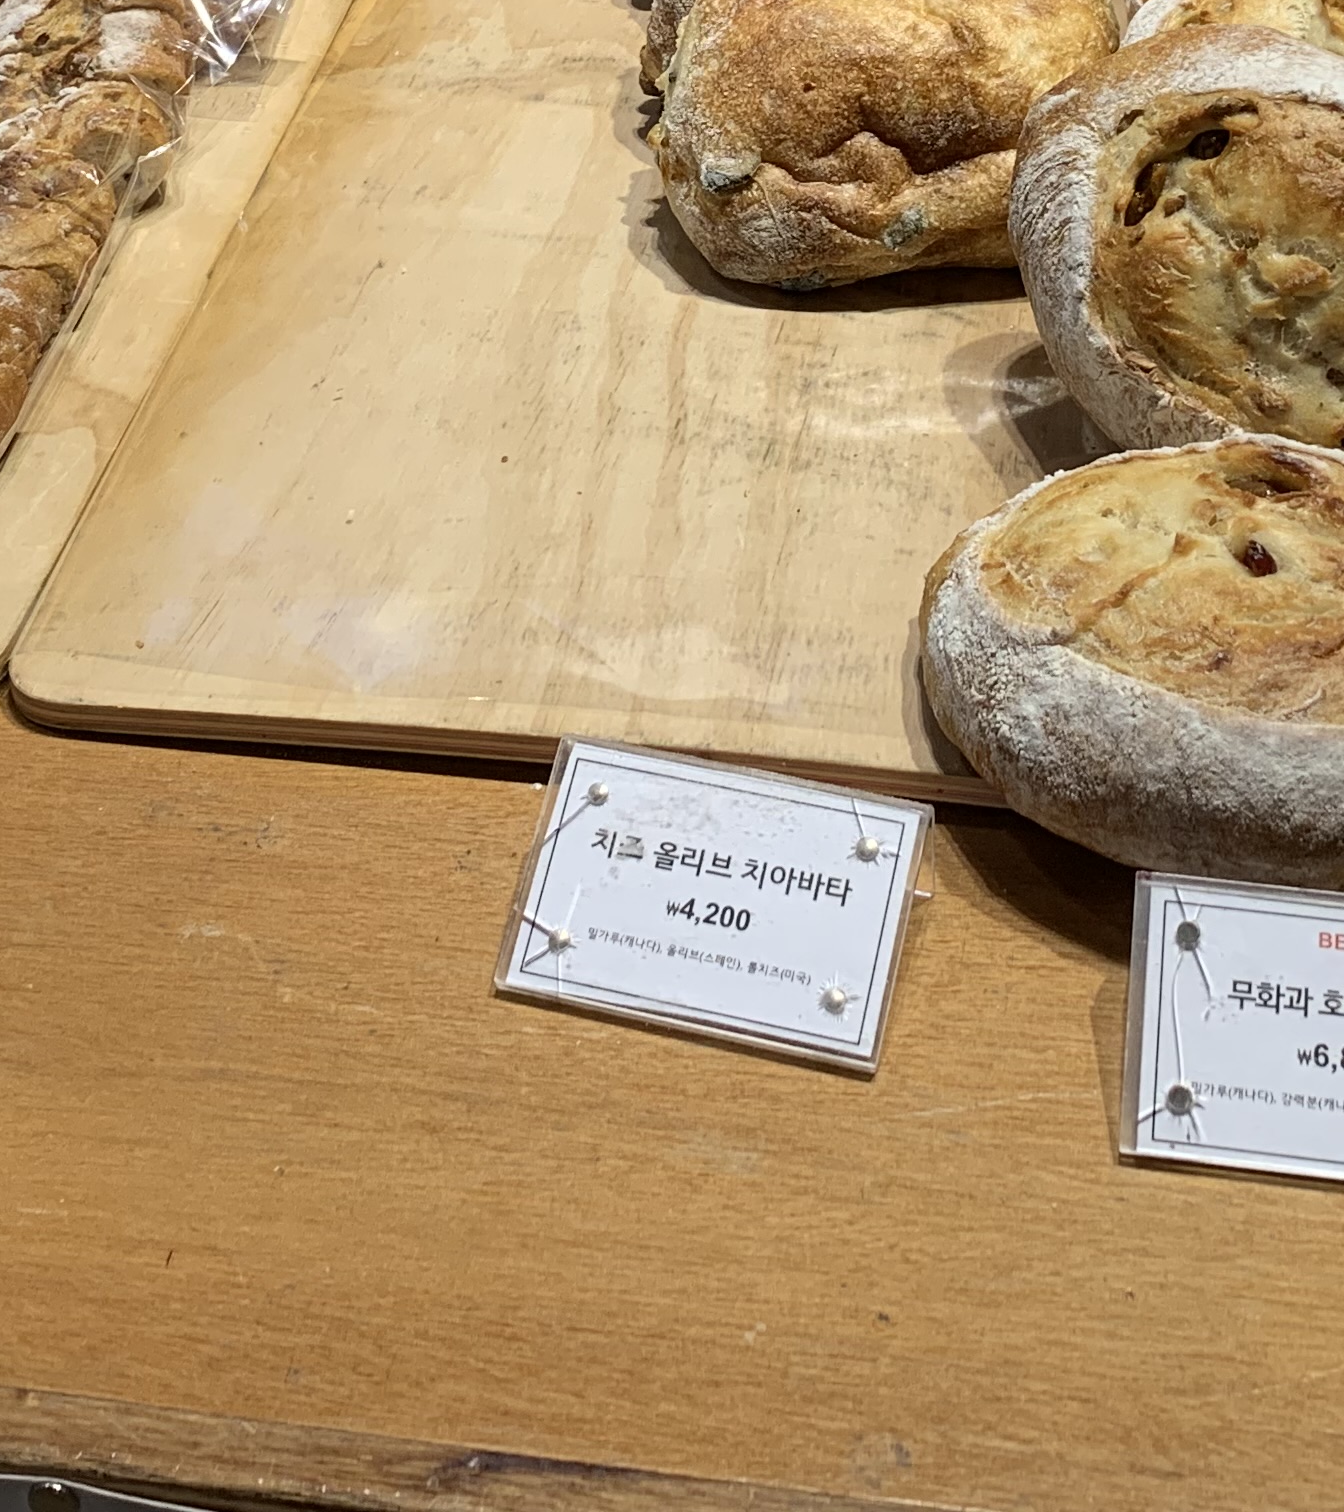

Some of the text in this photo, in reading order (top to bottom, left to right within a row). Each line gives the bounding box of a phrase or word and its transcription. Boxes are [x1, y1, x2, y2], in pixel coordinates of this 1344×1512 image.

[591, 828, 854, 908] 치즈 올리브 치아바타
[666, 897, 752, 932] ₩4,200
[1227, 979, 1315, 1018] 무화과
